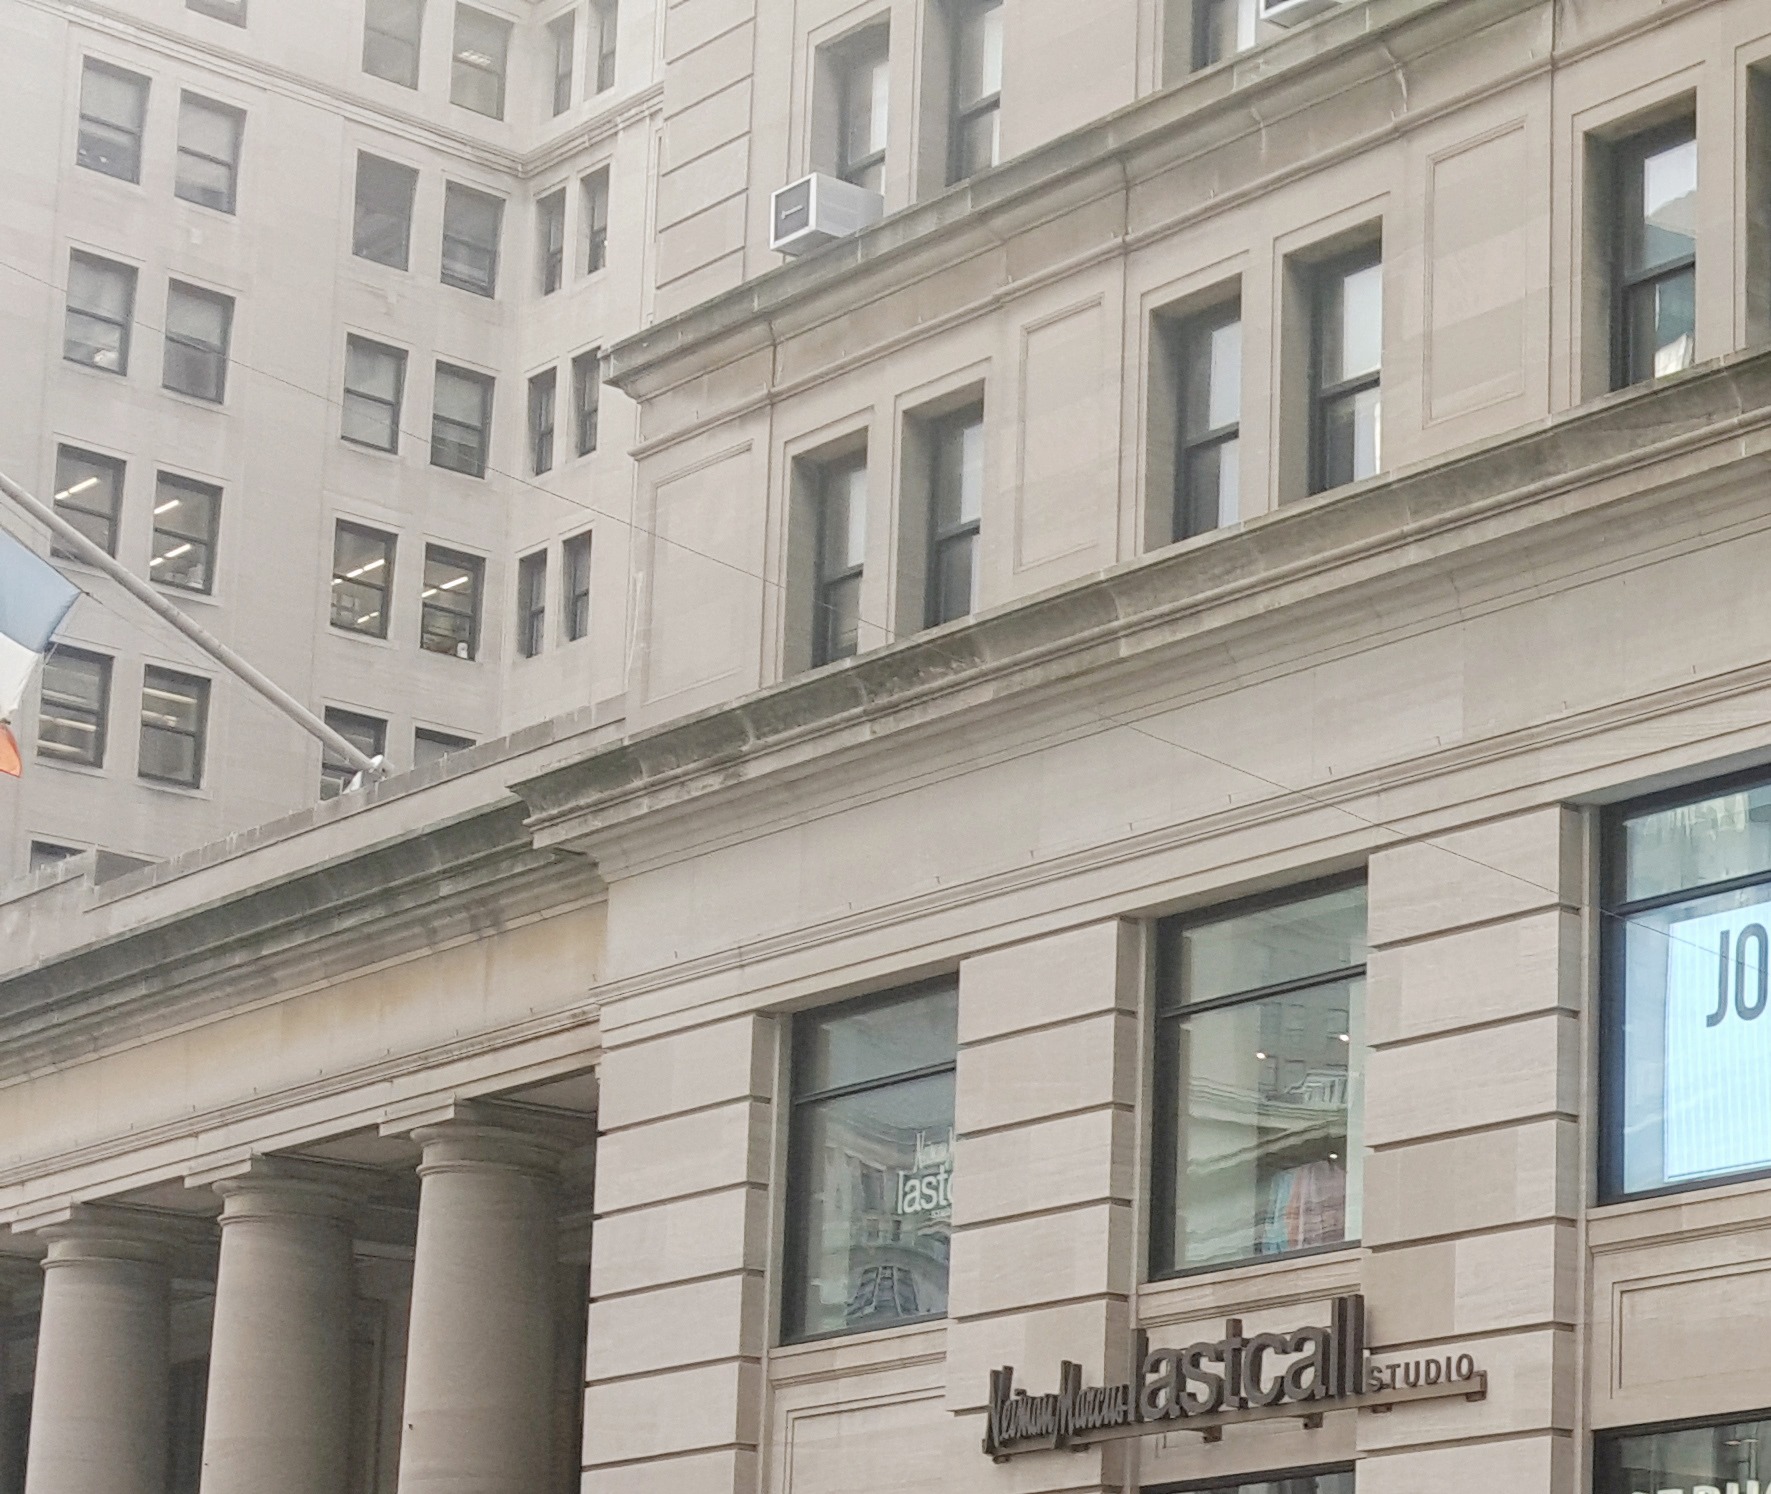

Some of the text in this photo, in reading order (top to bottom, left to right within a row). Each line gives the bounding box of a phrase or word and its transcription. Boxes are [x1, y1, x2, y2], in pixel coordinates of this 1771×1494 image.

[983, 1294, 1476, 1454] Neiman Marcus lastcall STUDIO
